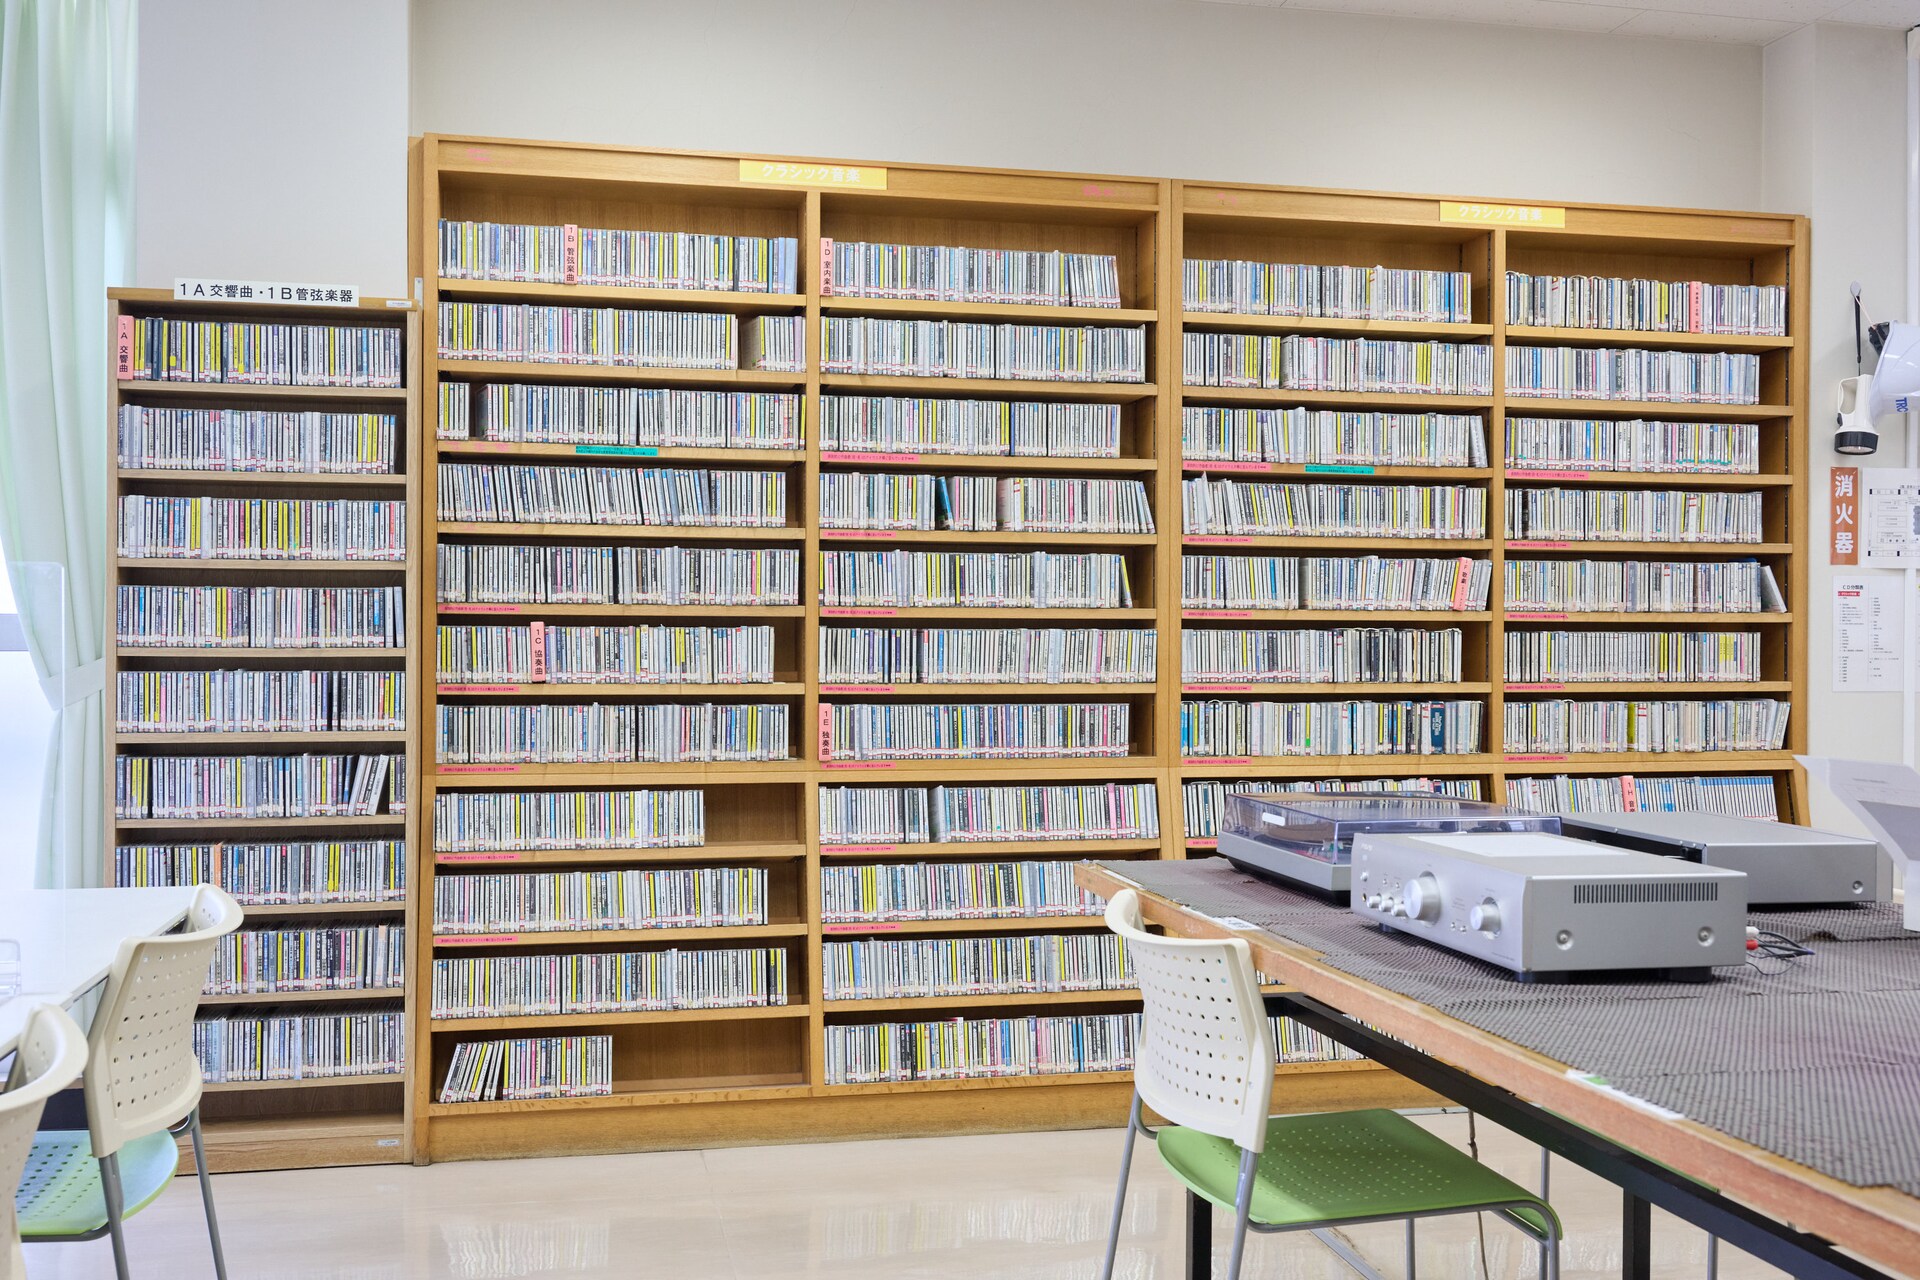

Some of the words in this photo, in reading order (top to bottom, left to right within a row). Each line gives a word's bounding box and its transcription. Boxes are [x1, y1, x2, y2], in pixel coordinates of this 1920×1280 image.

[762, 163, 860, 183] クラシック音楽
[1895, 396, 1909, 413] TRC
[1834, 474, 1854, 554] 消火器
